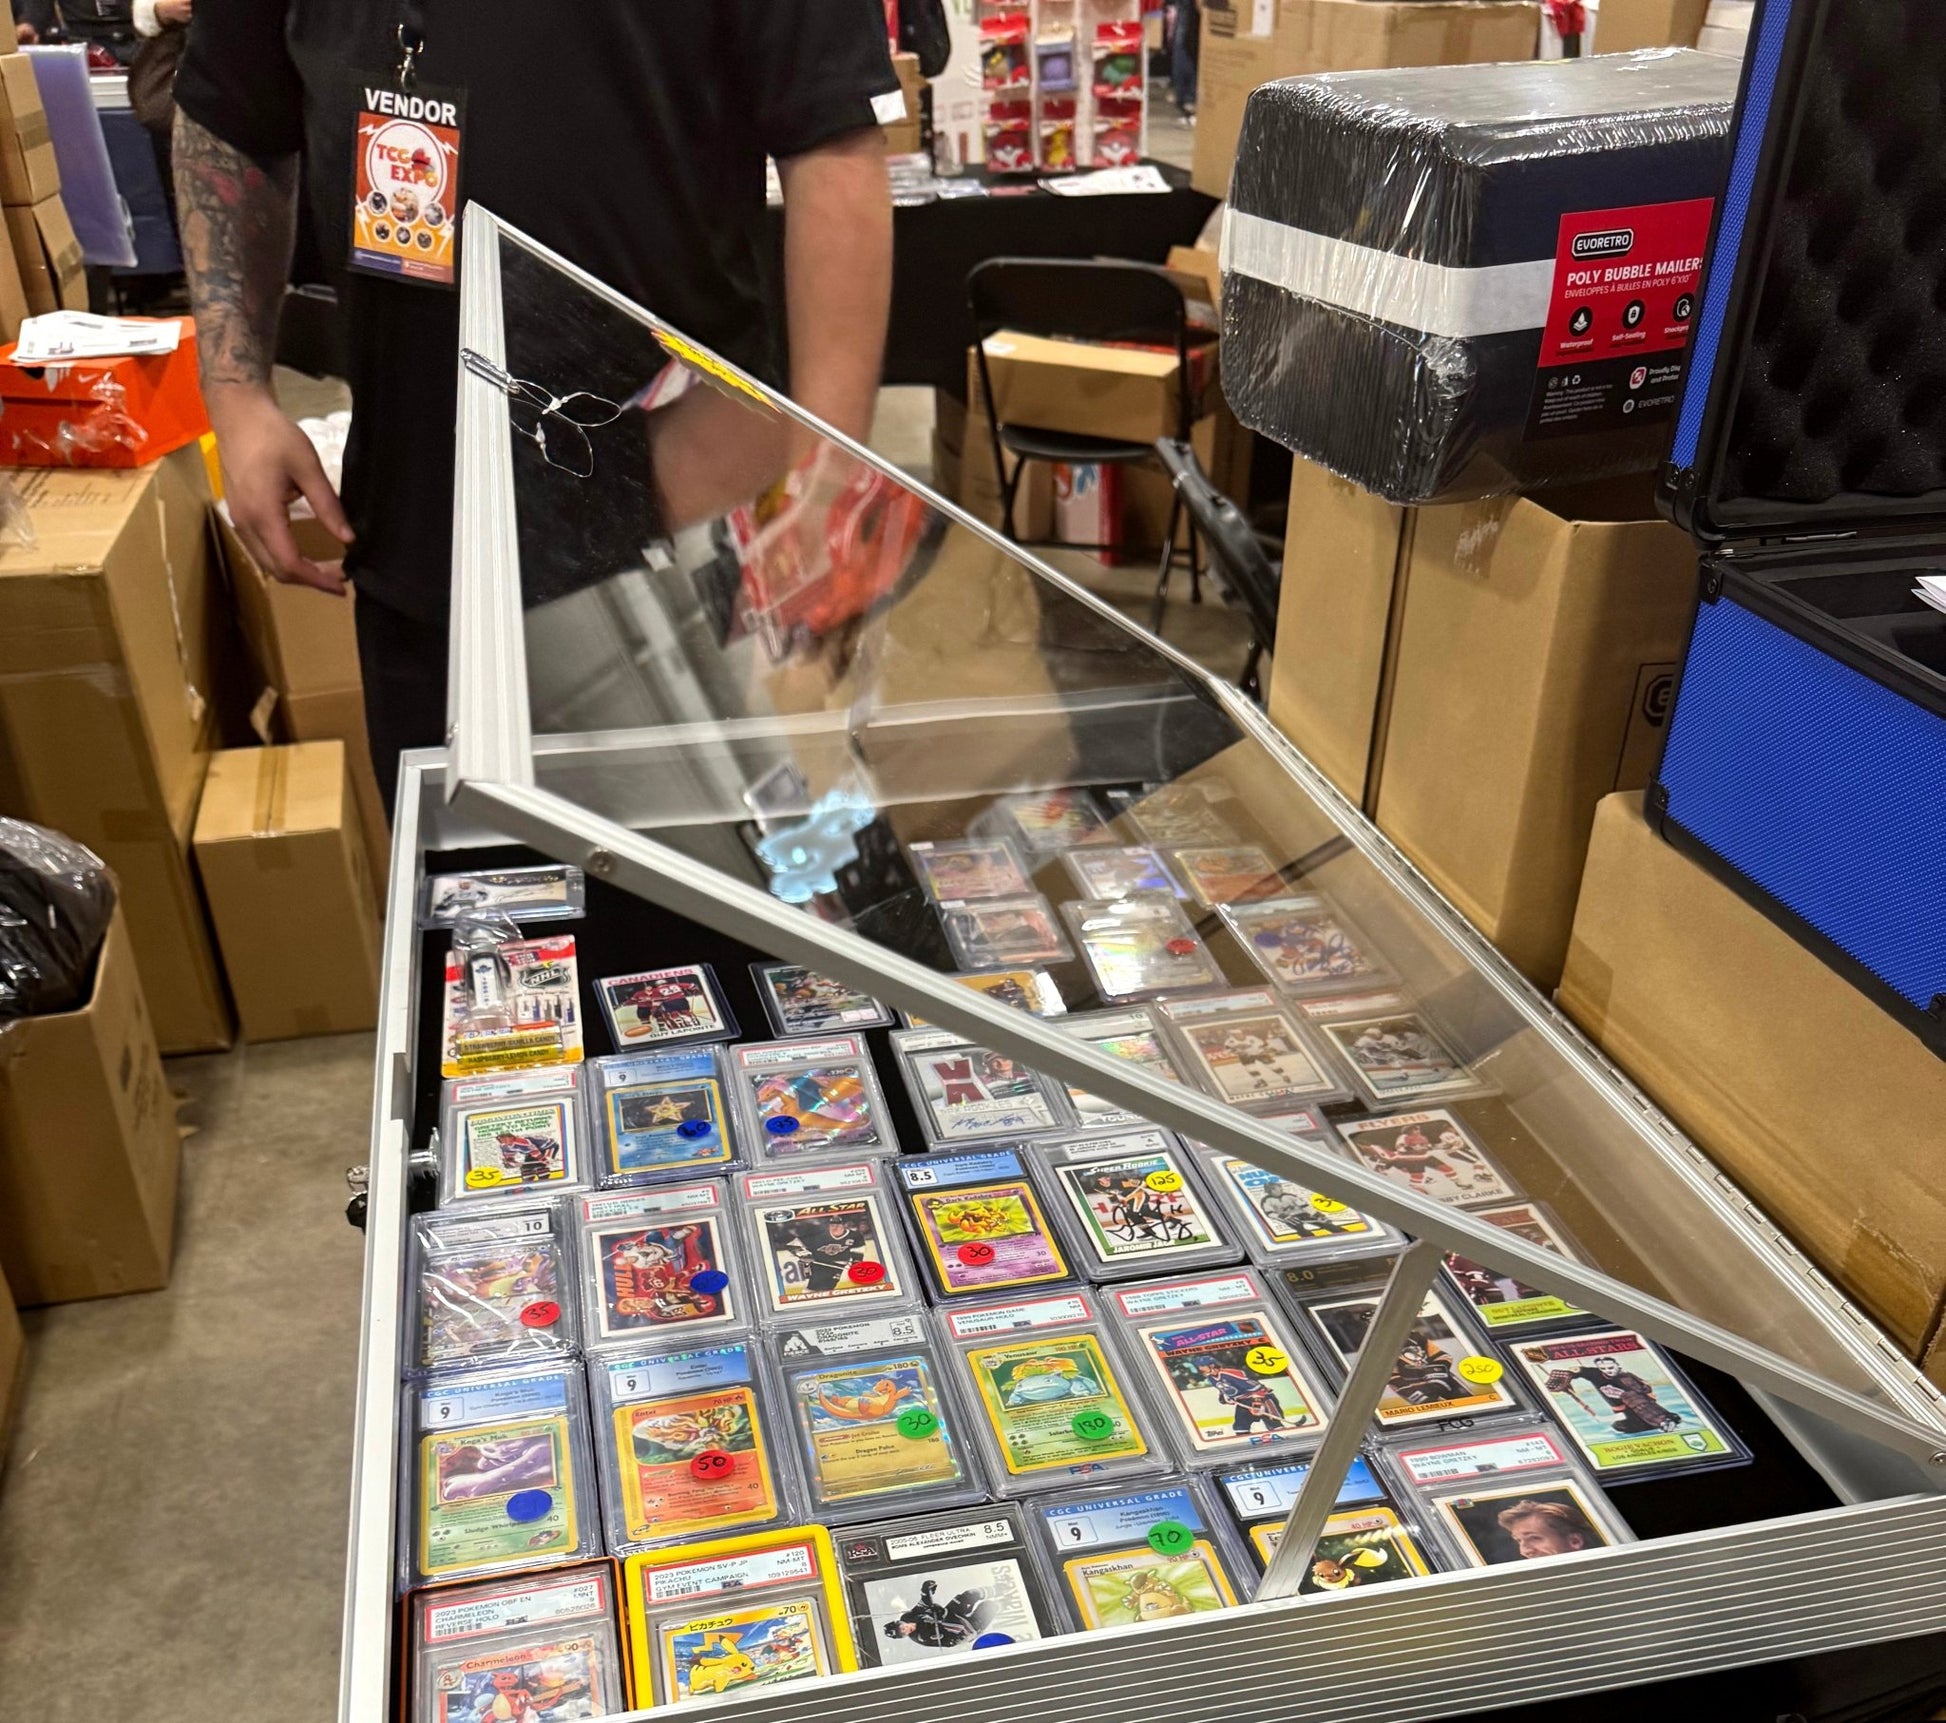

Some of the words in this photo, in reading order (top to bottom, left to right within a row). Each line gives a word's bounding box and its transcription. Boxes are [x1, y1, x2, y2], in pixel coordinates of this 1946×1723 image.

[364, 87, 457, 126] VENDOR
[376, 143, 412, 164] TCG
[390, 164, 438, 188] EXPO
[1576, 234, 1630, 251] EVORETRO
[1566, 269, 1602, 286] POLY
[1604, 263, 1653, 282] BUBBLE
[1564, 284, 1610, 299] ENVELOPPES
[1616, 280, 1641, 292] BULLES
[1642, 279, 1651, 289] EN
[1652, 277, 1670, 288] POLY
[607, 968, 694, 986] CANADIENS
[619, 1073, 627, 1082] 9
[1356, 1112, 1431, 1131] FLYERS
[904, 1161, 924, 1169] CGC
[926, 1154, 977, 1166] UNIVERSAL
[980, 1149, 1012, 1159] GRADE
[470, 1169, 501, 1182] 35
[909, 1170, 932, 1182] 8.5
[1151, 1172, 1176, 1187] 125
[525, 1221, 543, 1232] 10
[966, 1246, 992, 1258] 30
[1112, 1242, 1152, 1254] JAROMIR
[1286, 1270, 1315, 1283] 8.0
[786, 1290, 832, 1302] WAYNE
[526, 1304, 551, 1320] 35
[833, 1322, 871, 1331] POKEMON
[892, 1325, 914, 1337] 8.5
[1176, 1328, 1228, 1347] ALL-STAR
[1165, 1346, 1202, 1357] WAYNE
[1251, 1350, 1285, 1367] 35
[427, 1389, 449, 1398] CGC
[454, 1380, 519, 1394] UNIVERSAL
[521, 1374, 560, 1385] GRADE
[626, 1379, 637, 1392] 9
[440, 1406, 451, 1420] 9
[1384, 1407, 1415, 1418] MARIO
[1415, 1401, 1455, 1413] LEMIEUX
[901, 1413, 932, 1431] 30
[460, 1436, 488, 1446] Koga's
[1250, 1433, 1286, 1446] PSA
[855, 1446, 878, 1455] Dragon
[1429, 1450, 1467, 1461] BOWMAN
[697, 1454, 728, 1471] 50
[1412, 1459, 1443, 1469] WAYNE
[1442, 1454, 1479, 1466] GRETZKY
[1068, 1463, 1106, 1476] PSA
[1229, 1473, 1252, 1483] CGC
[1049, 1507, 1073, 1517] CGC
[1076, 1497, 1141, 1513] UNIVERSAL
[1145, 1490, 1185, 1502] GRADE
[1252, 1491, 1266, 1506] 9
[947, 1527, 972, 1537] ULTRA
[982, 1522, 1006, 1534] 8.5
[1070, 1526, 1082, 1542] 9
[909, 1536, 945, 1548] ALEXANDER
[945, 1532, 977, 1543] OVECHKIN
[1150, 1529, 1183, 1548] 70
[776, 1555, 806, 1566] NM-MT
[654, 1572, 675, 1581] 2023
[675, 1564, 717, 1578] POKEMON
[738, 1559, 749, 1568] JP
[1082, 1562, 1134, 1577] Kangaskhan
[572, 1584, 594, 1593] #027
[654, 1575, 692, 1587] PIKACHU
[655, 1583, 676, 1593] GYM
[676, 1578, 704, 1590] EVENT
[704, 1571, 750, 1585] CAMPAIGN
[572, 1590, 595, 1600] MINT
[434, 1608, 458, 1619] 2023
[457, 1601, 501, 1615] POKEMON
[519, 1595, 532, 1604] EN
[782, 1605, 797, 1615] 70
[434, 1609, 495, 1625] CHARMELEON
[434, 1617, 473, 1631] REVERSE
[475, 1614, 500, 1625] HOLO
[689, 1618, 734, 1632] ピカチュウ
[465, 1653, 528, 1670] Charmeleon
